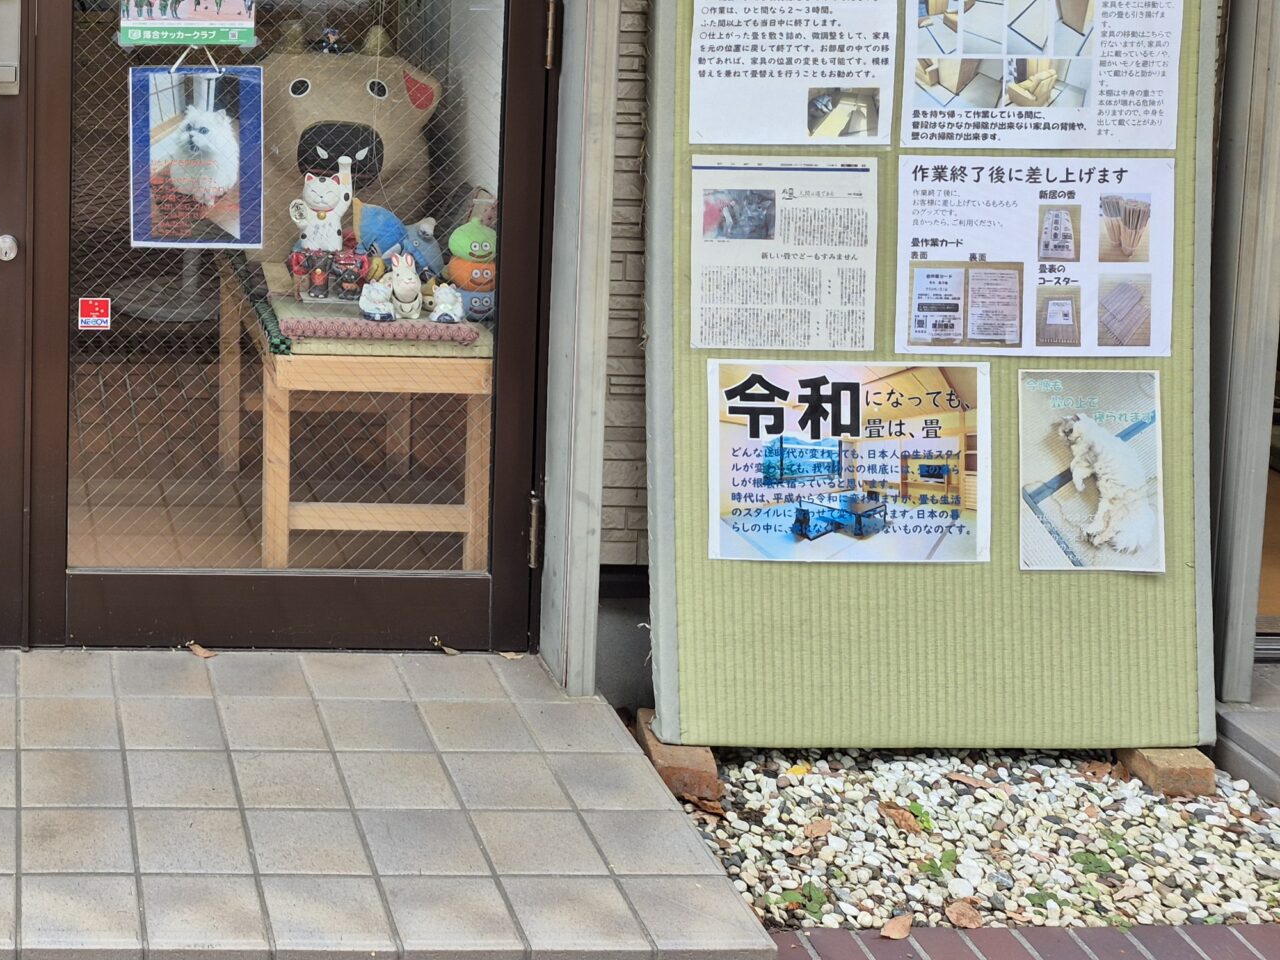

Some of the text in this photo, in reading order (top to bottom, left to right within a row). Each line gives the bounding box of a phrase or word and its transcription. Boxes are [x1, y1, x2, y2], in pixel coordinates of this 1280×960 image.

[143, 30, 216, 39] 落合サッカークラブ
[912, 165, 1129, 184] 作業終了後に差し上げます
[911, 238, 963, 247] 畳作業カード
[911, 251, 928, 259] 表面
[1038, 277, 1078, 286] コースター
[866, 389, 972, 409] になっても、
[724, 373, 862, 440] 令和
[865, 418, 942, 439] 畳は、畳
